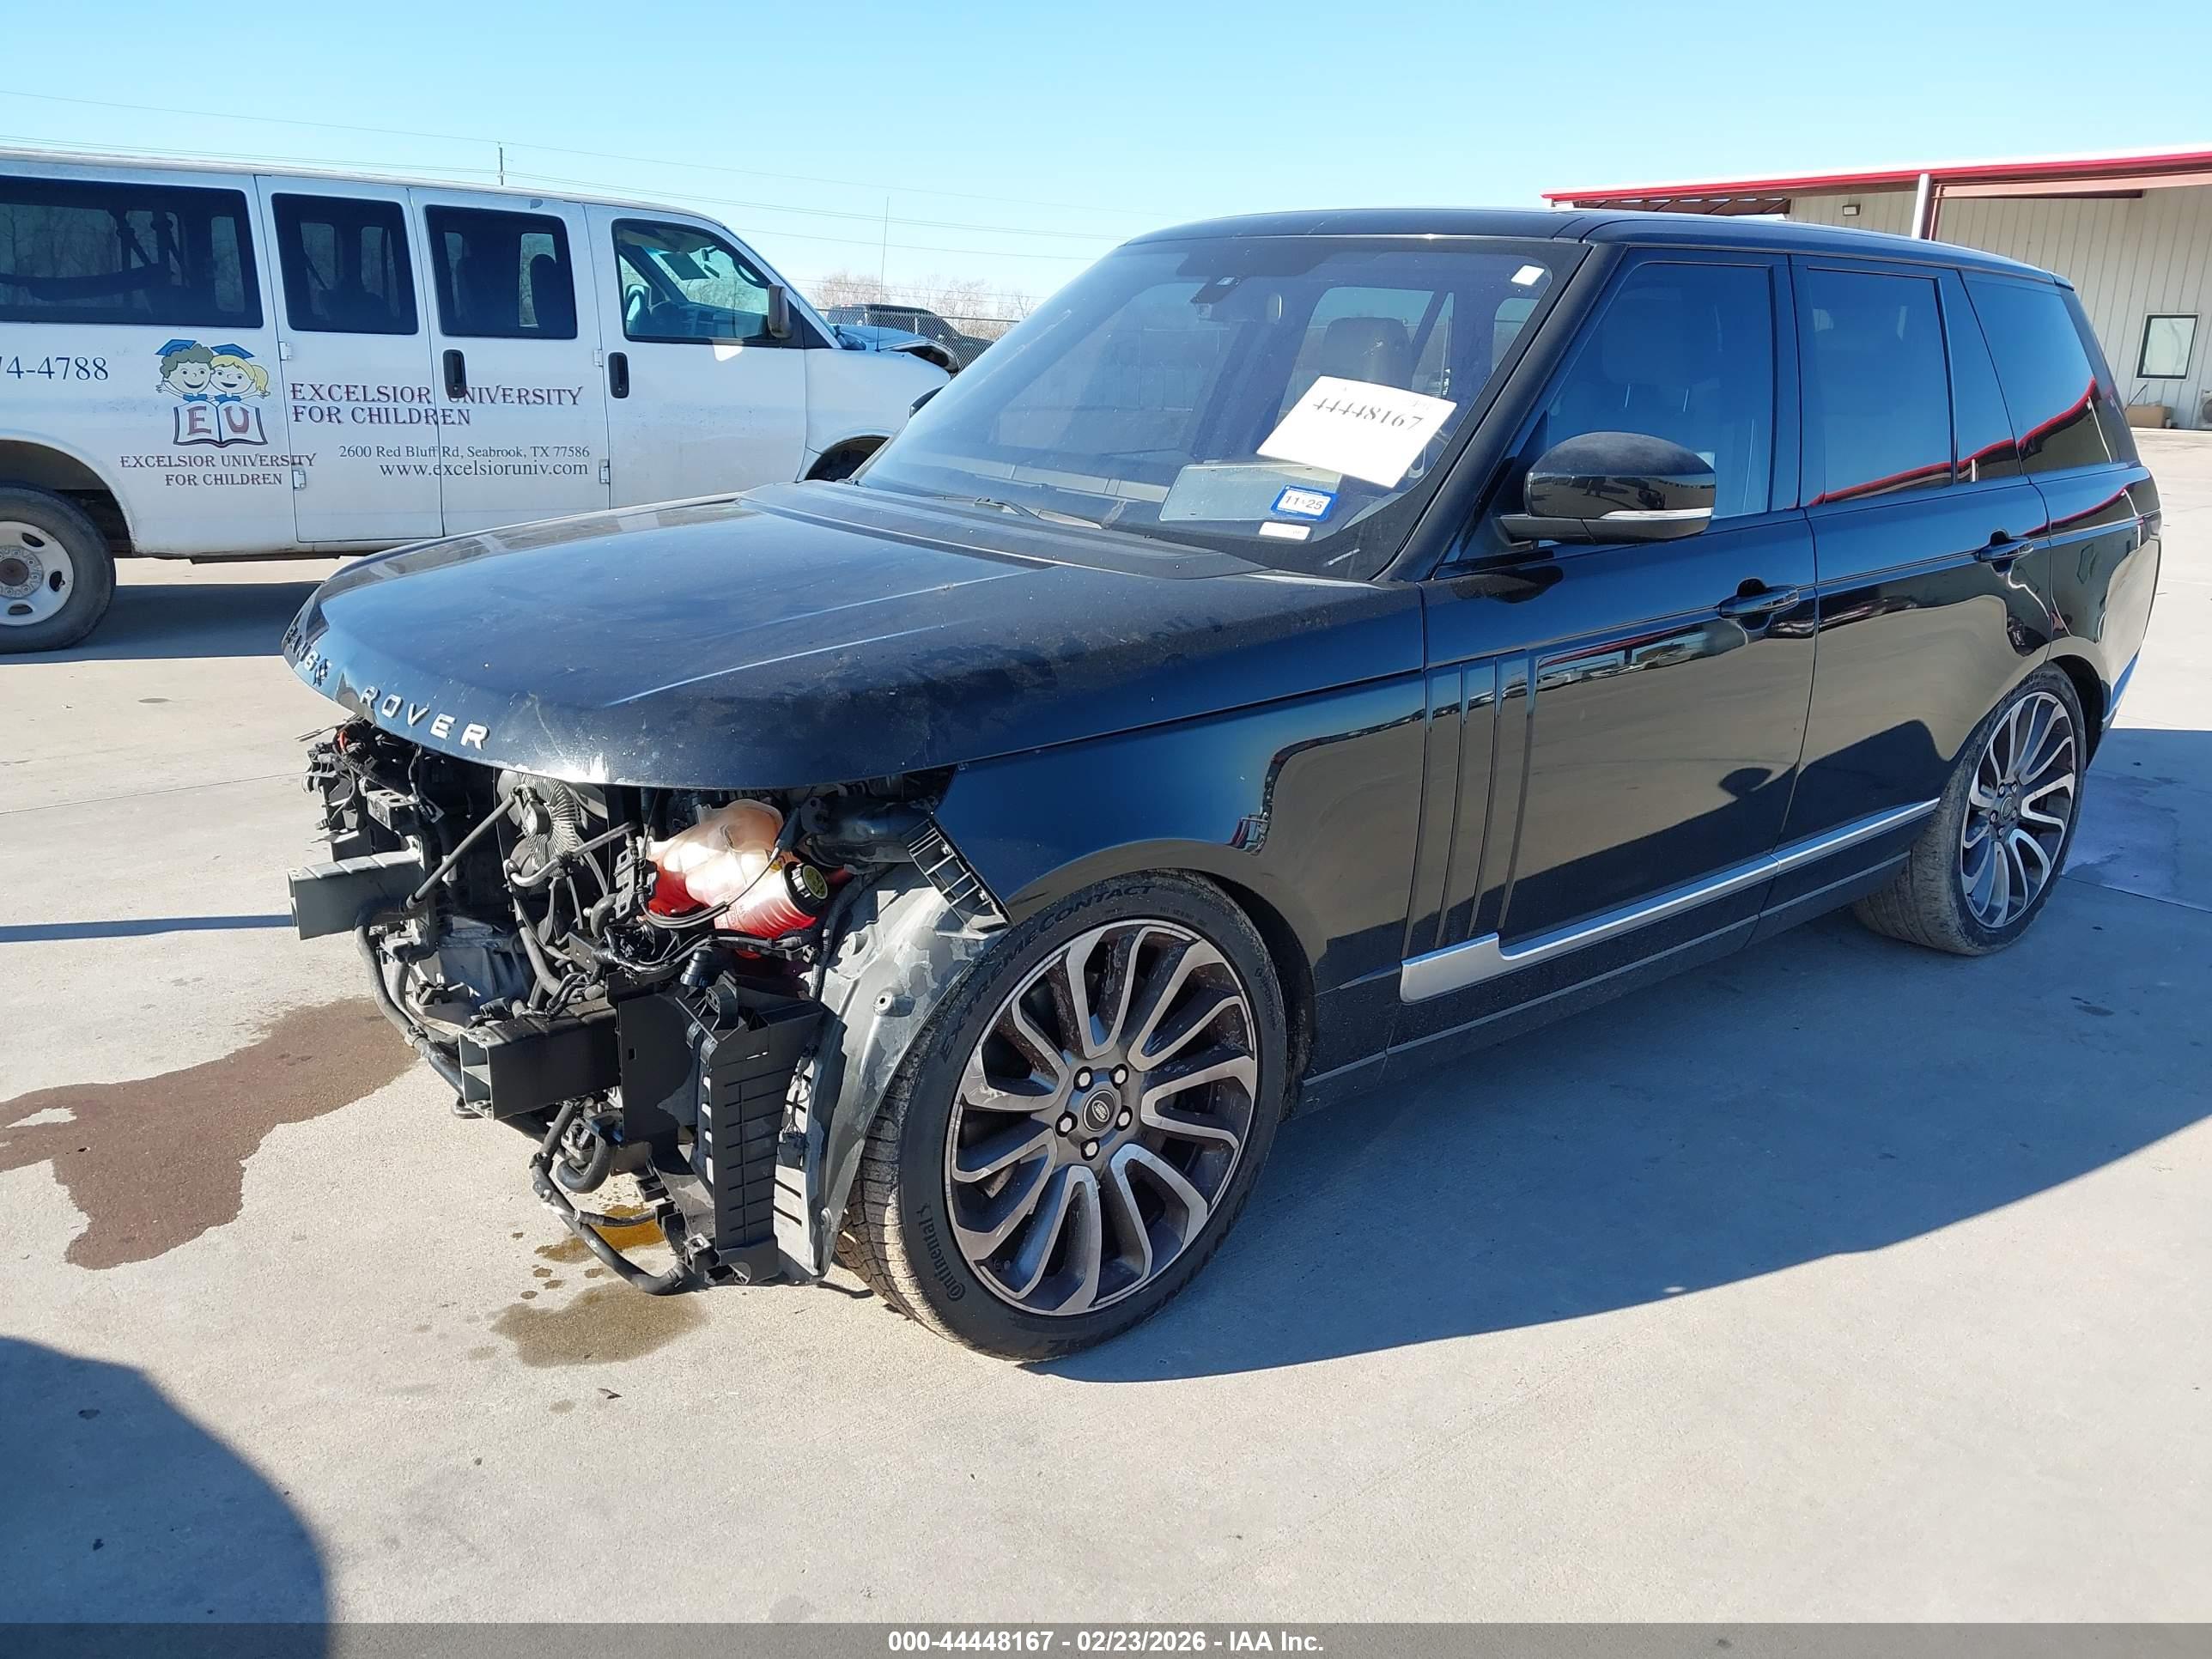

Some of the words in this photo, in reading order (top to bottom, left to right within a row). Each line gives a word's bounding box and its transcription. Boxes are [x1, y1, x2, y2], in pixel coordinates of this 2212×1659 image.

[0, 356, 108, 380] 4-4788
[289, 383, 432, 404] EXCELSIOR
[292, 405, 343, 424] FOR
[350, 406, 471, 426] CHILDREN
[1313, 398, 1424, 430] 44448167
[120, 455, 216, 468] EXCELSIOR
[221, 453, 317, 466] UNIVERSITY
[339, 446, 372, 458] 2600
[376, 446, 401, 458] Red
[405, 445, 439, 458] Bluff
[441, 447, 464, 459] Rd,
[466, 446, 526, 459] Seabrook,
[530, 447, 550, 457] TX
[554, 446, 590, 458] 77586
[380, 460, 588, 476] www.excelsioruniv.com
[165, 474, 199, 486] FOR
[203, 473, 283, 485] CHILDREN
[359, 686, 489, 750] ROVER
[919, 1217, 966, 1302] Continental
